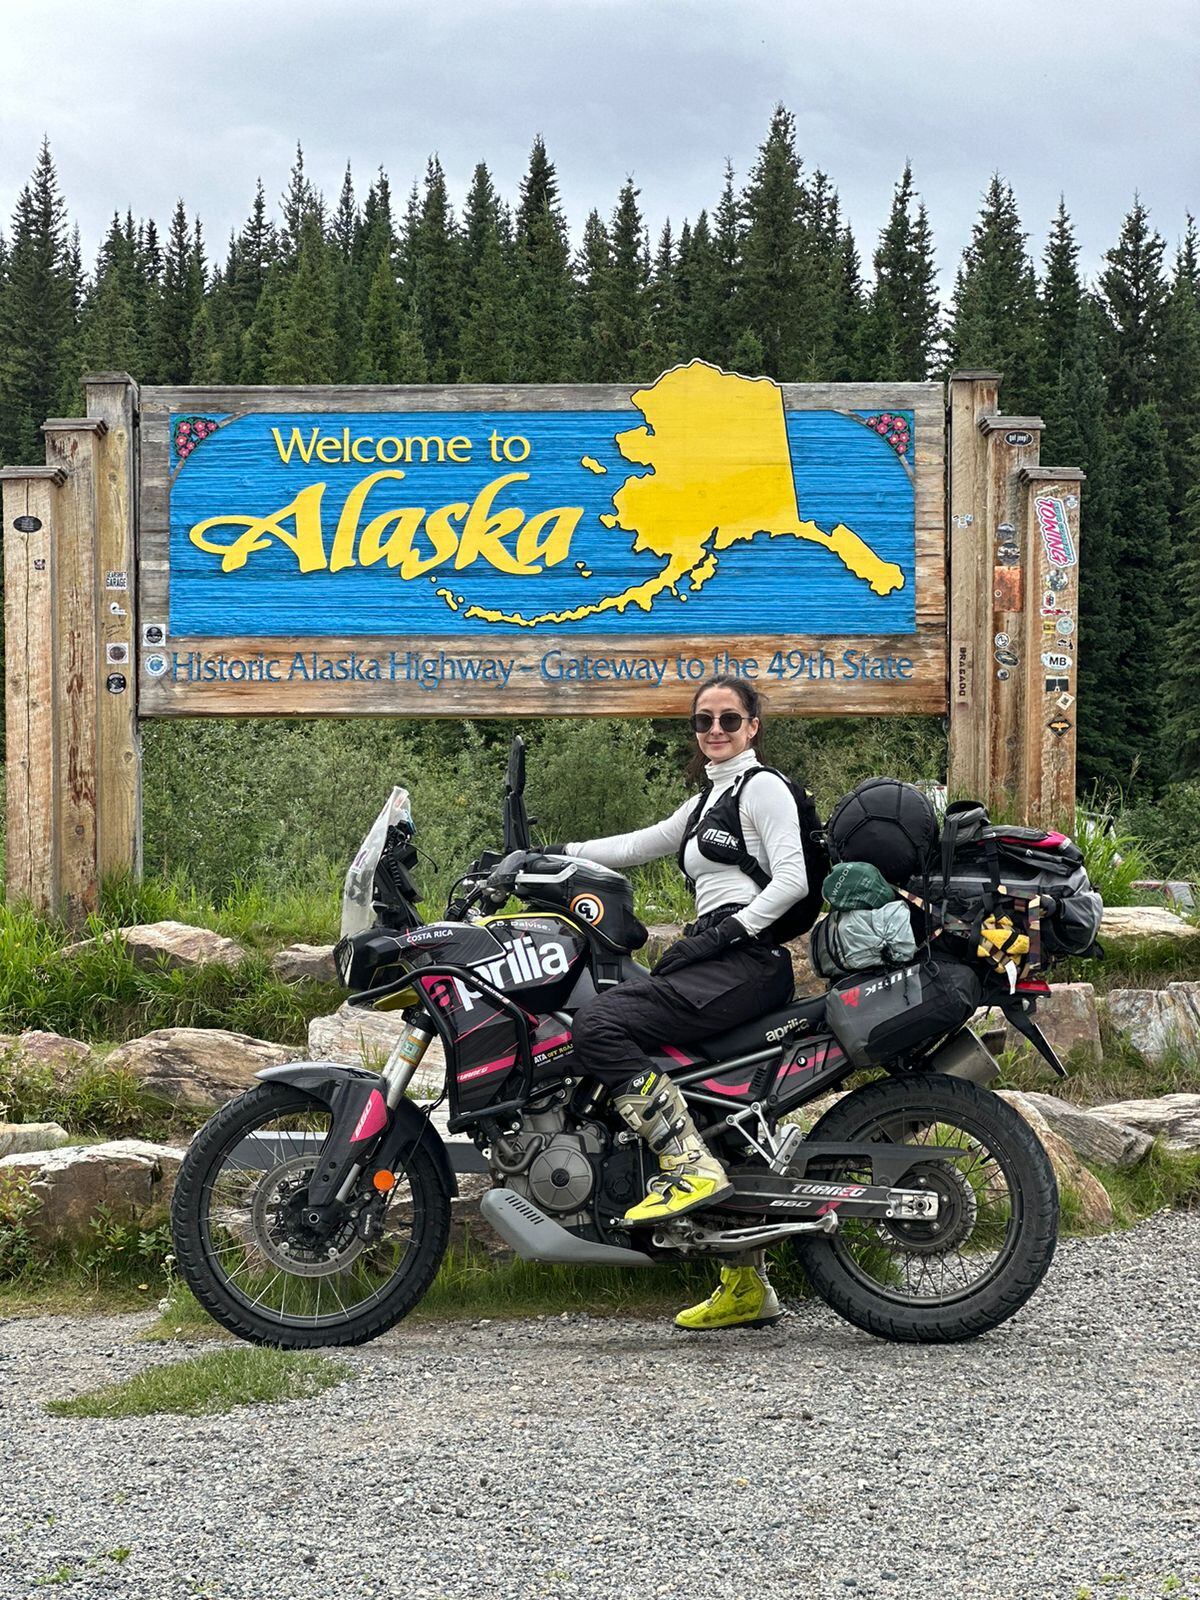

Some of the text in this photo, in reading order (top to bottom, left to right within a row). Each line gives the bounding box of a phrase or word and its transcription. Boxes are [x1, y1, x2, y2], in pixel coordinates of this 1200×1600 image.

[271, 427, 531, 464] Welcome to
[188, 470, 584, 581] Alaska
[1039, 500, 1069, 563] TOWING
[171, 652, 281, 682] Historic
[291, 652, 381, 682] Alaska
[389, 652, 515, 690] Highway
[540, 650, 670, 689] Gateway
[676, 654, 706, 681] to
[712, 650, 759, 681] the
[768, 650, 835, 681] 49th
[842, 650, 914, 681] State
[1049, 657, 1067, 666] MB
[406, 929, 454, 944] COSTA RICA
[428, 935, 570, 1012] aprilia
[765, 1018, 810, 1042] aprilia
[533, 1055, 548, 1064] ATA
[769, 1200, 812, 1208] 660
